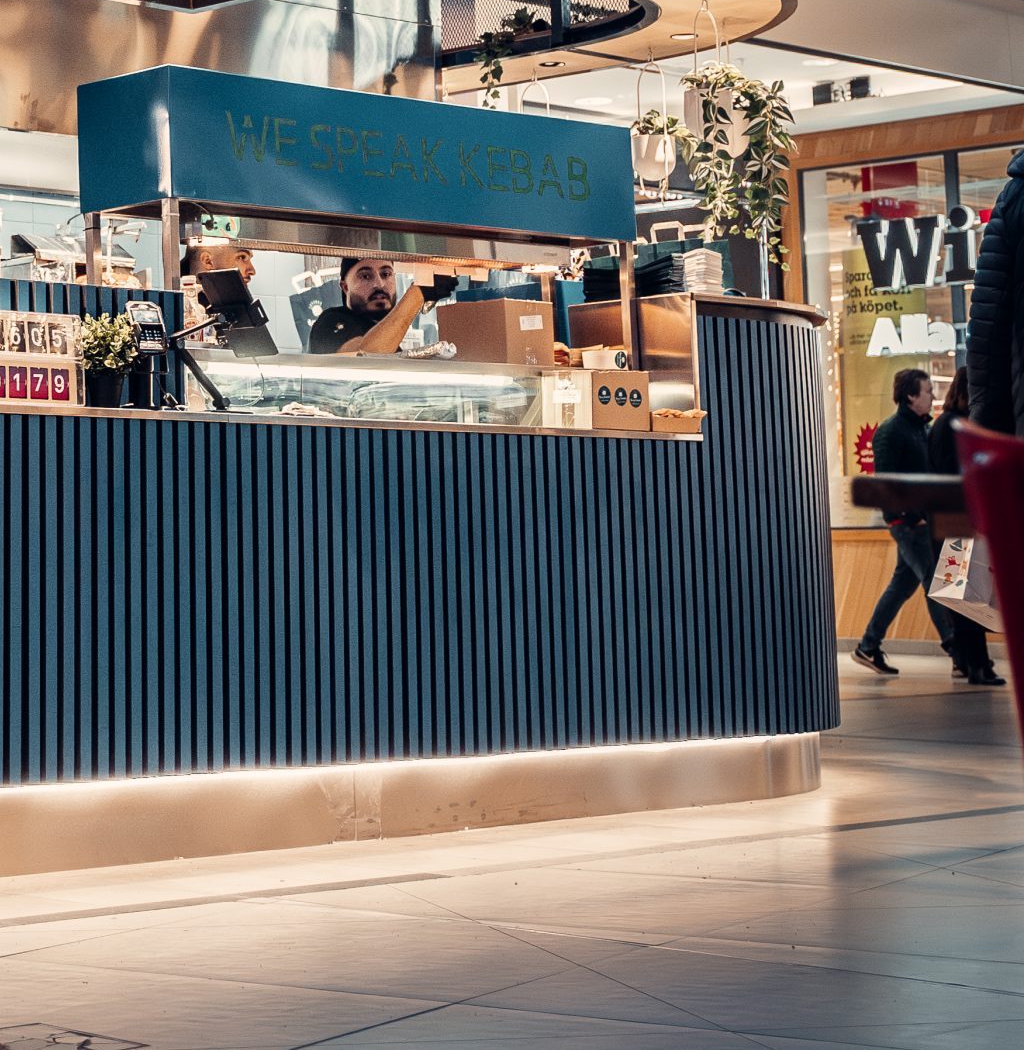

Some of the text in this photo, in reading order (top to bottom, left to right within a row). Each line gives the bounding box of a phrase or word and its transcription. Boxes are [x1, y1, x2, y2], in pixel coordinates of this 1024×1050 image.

[225, 109, 591, 202] WE SPEAK KEBAB
[859, 299, 904, 314] köpet.
